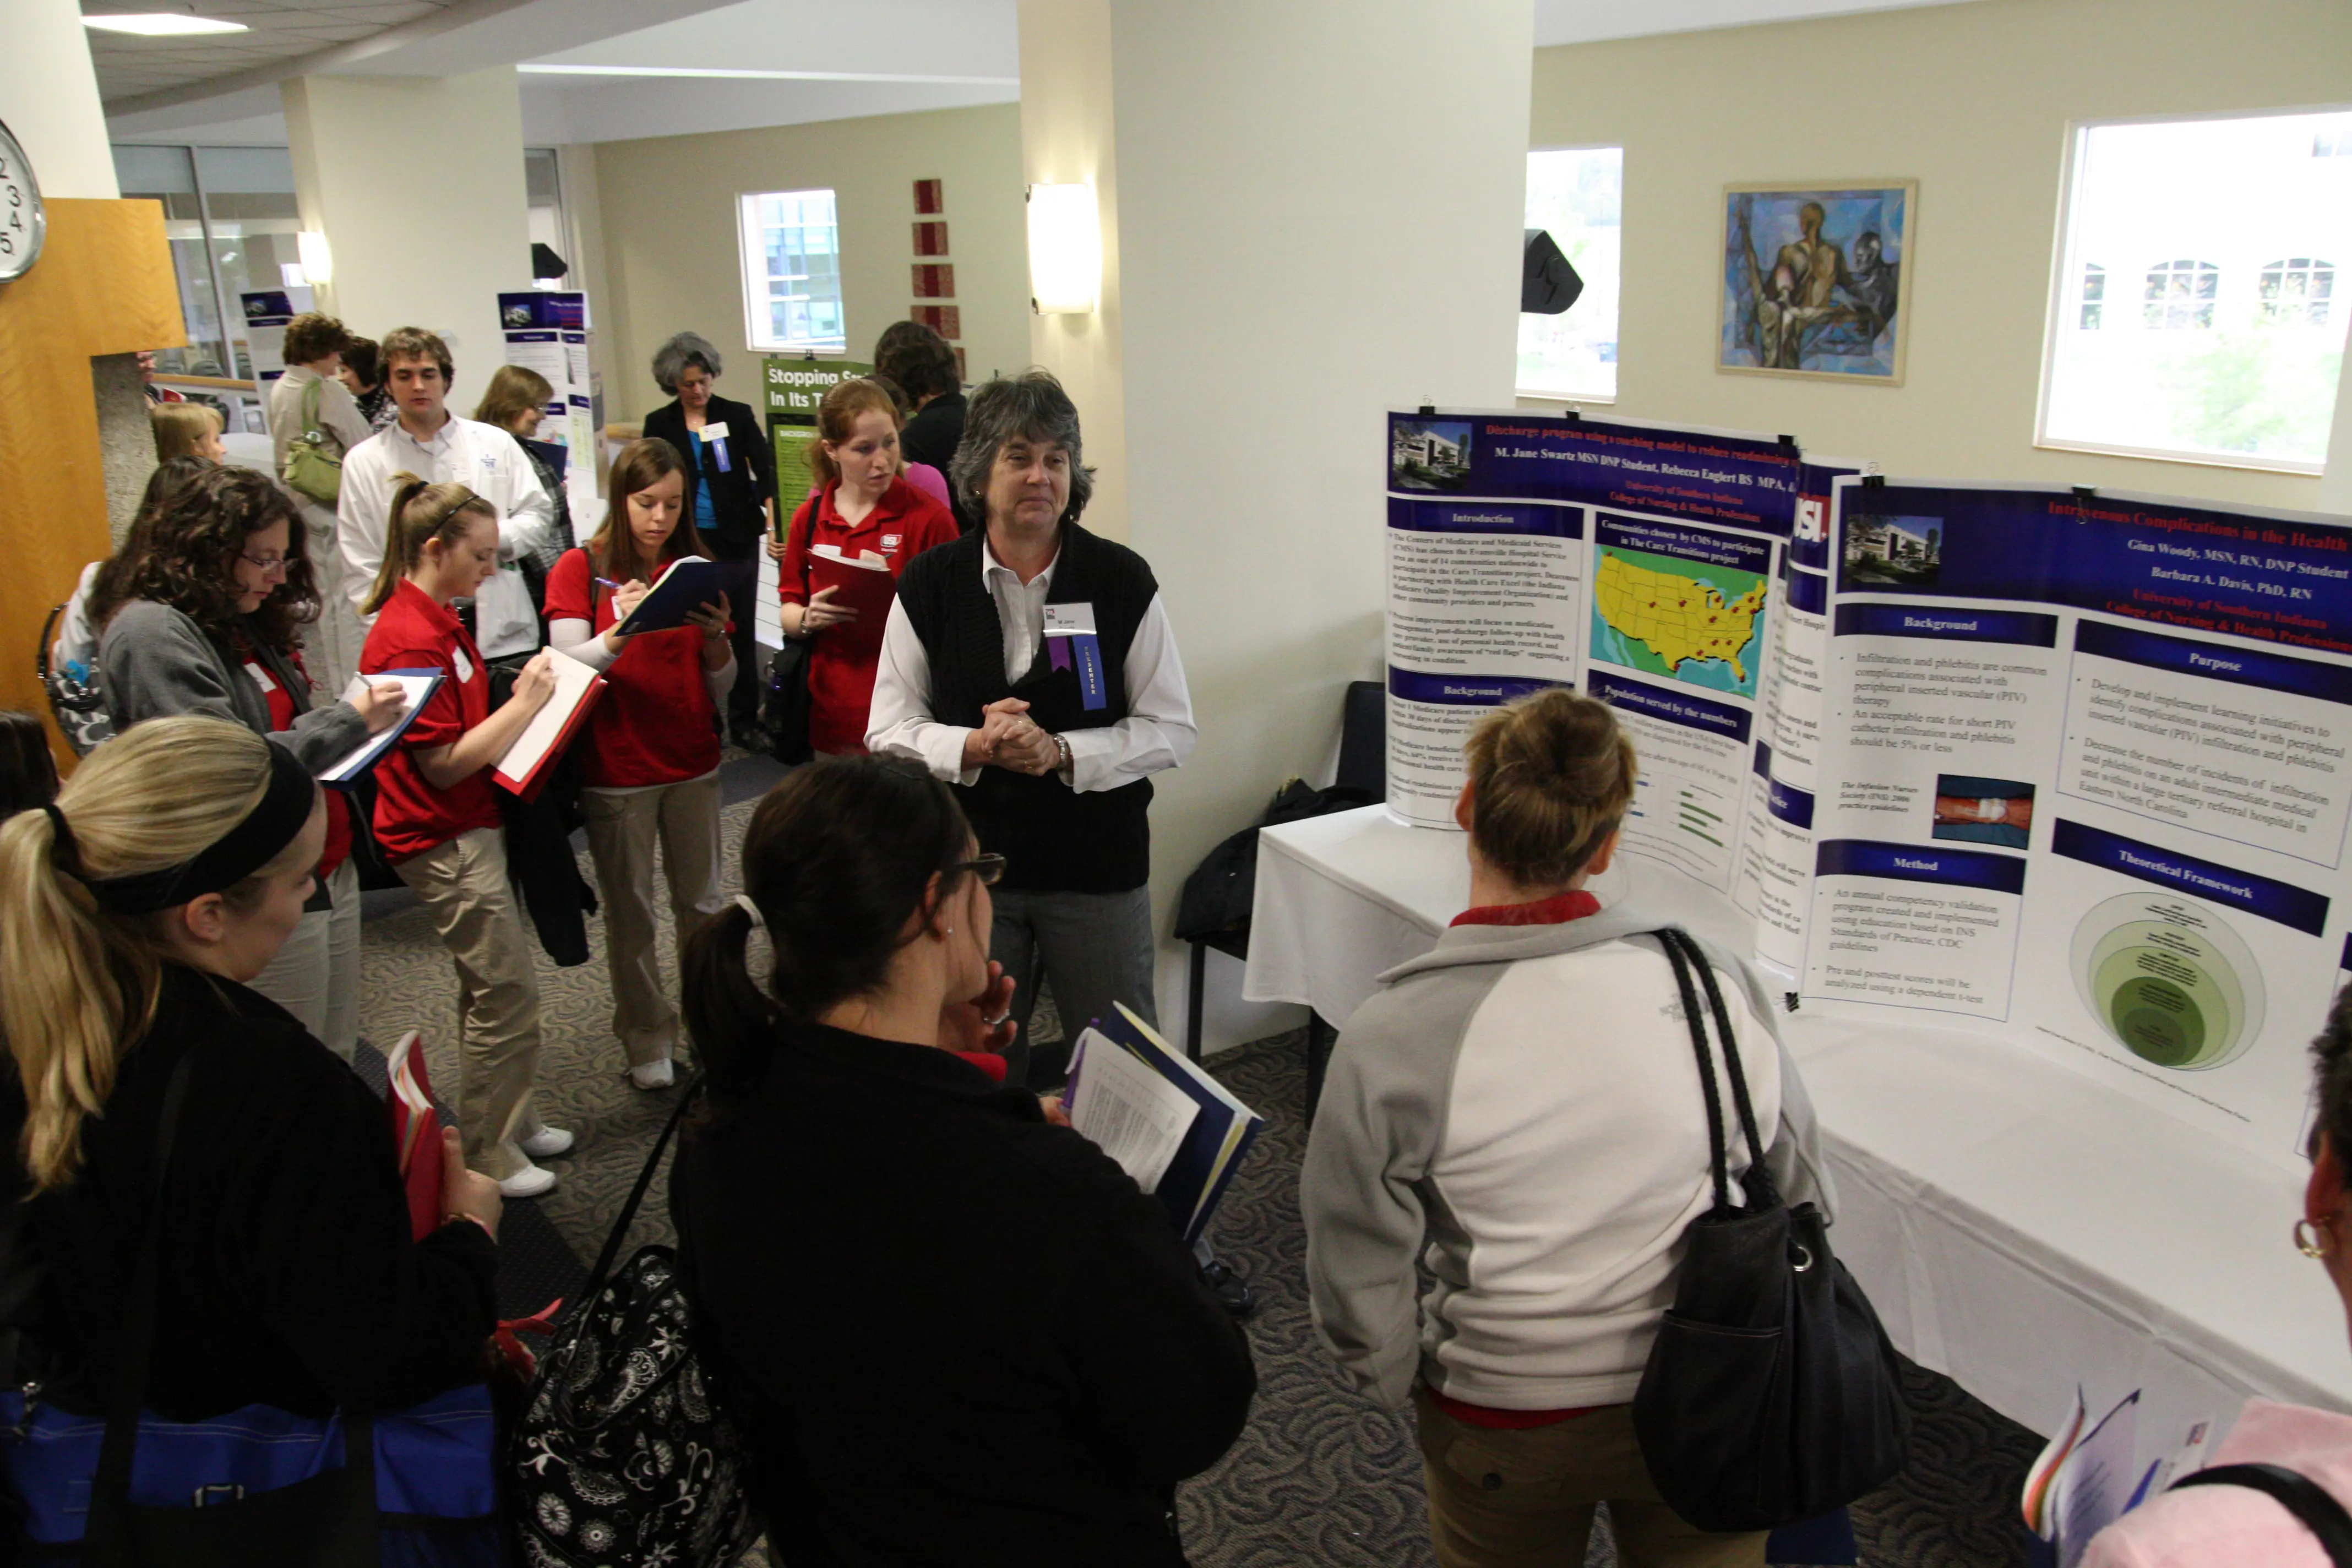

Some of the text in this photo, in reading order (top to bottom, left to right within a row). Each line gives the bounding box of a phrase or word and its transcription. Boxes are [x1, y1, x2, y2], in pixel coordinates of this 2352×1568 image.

[6, 184, 22, 208] 3
[9, 210, 23, 233] 4
[0, 232, 13, 254] 5
[768, 368, 839, 387] Stopping
[770, 390, 785, 407] In
[788, 391, 809, 407] Its
[1486, 424, 1539, 438] Discharge
[1541, 428, 1583, 440] program
[1687, 444, 1697, 453] to
[1494, 447, 1786, 492] M. Jane Swartz MSN DNP Student, Rebecca Englert BS MPA,
[1626, 479, 1664, 496] University
[1666, 486, 1676, 495] of
[1452, 513, 1515, 524] Introduction
[1795, 497, 1823, 542] SI
[2048, 500, 2348, 552] Intravenous Complications in the Health
[1601, 519, 1766, 556] Communities chosen by CMS to participate
[1620, 536, 1740, 565] in The Care Transitions project
[2127, 538, 2349, 579] Gina Woody, MSN, RN, DNP Student
[2150, 565, 2313, 600] Barbara A. Davis, PhD, RN
[2132, 587, 2328, 630] University of Southern Indiana
[1904, 616, 1978, 631] Background
[2106, 600, 2352, 653] College of Nursing & Health Profession
[1856, 652, 2048, 677] Infiltration and phlebitis are common
[2188, 652, 2243, 671] Purpose
[1854, 668, 2008, 687] complications associated with
[1444, 685, 1502, 698] Background
[1853, 681, 2028, 704] peripheral inserted vascular (PIV)
[1853, 695, 1892, 708] therapy
[1604, 684, 1737, 728] Population served by the numbers
[2091, 678, 2332, 738] Develop and implement learning initiatives to
[1852, 709, 2017, 730] An acceptable rate for short PIV
[1849, 736, 1953, 753] should be 5% or less
[1850, 723, 2016, 745] catheter infiltration and phlebitis
[2088, 707, 2336, 773] inserted vascular (PIV) infiltration and phlebitis
[2079, 780, 2188, 819] Eastern North Carolina
[1893, 857, 1939, 871] Method
[2119, 848, 2253, 899] Theoretical Framework
[1832, 903, 2001, 928] program created and implemented
[1829, 941, 1879, 952] guidelines
[1830, 927, 1965, 949] Standards of Practice, CDC
